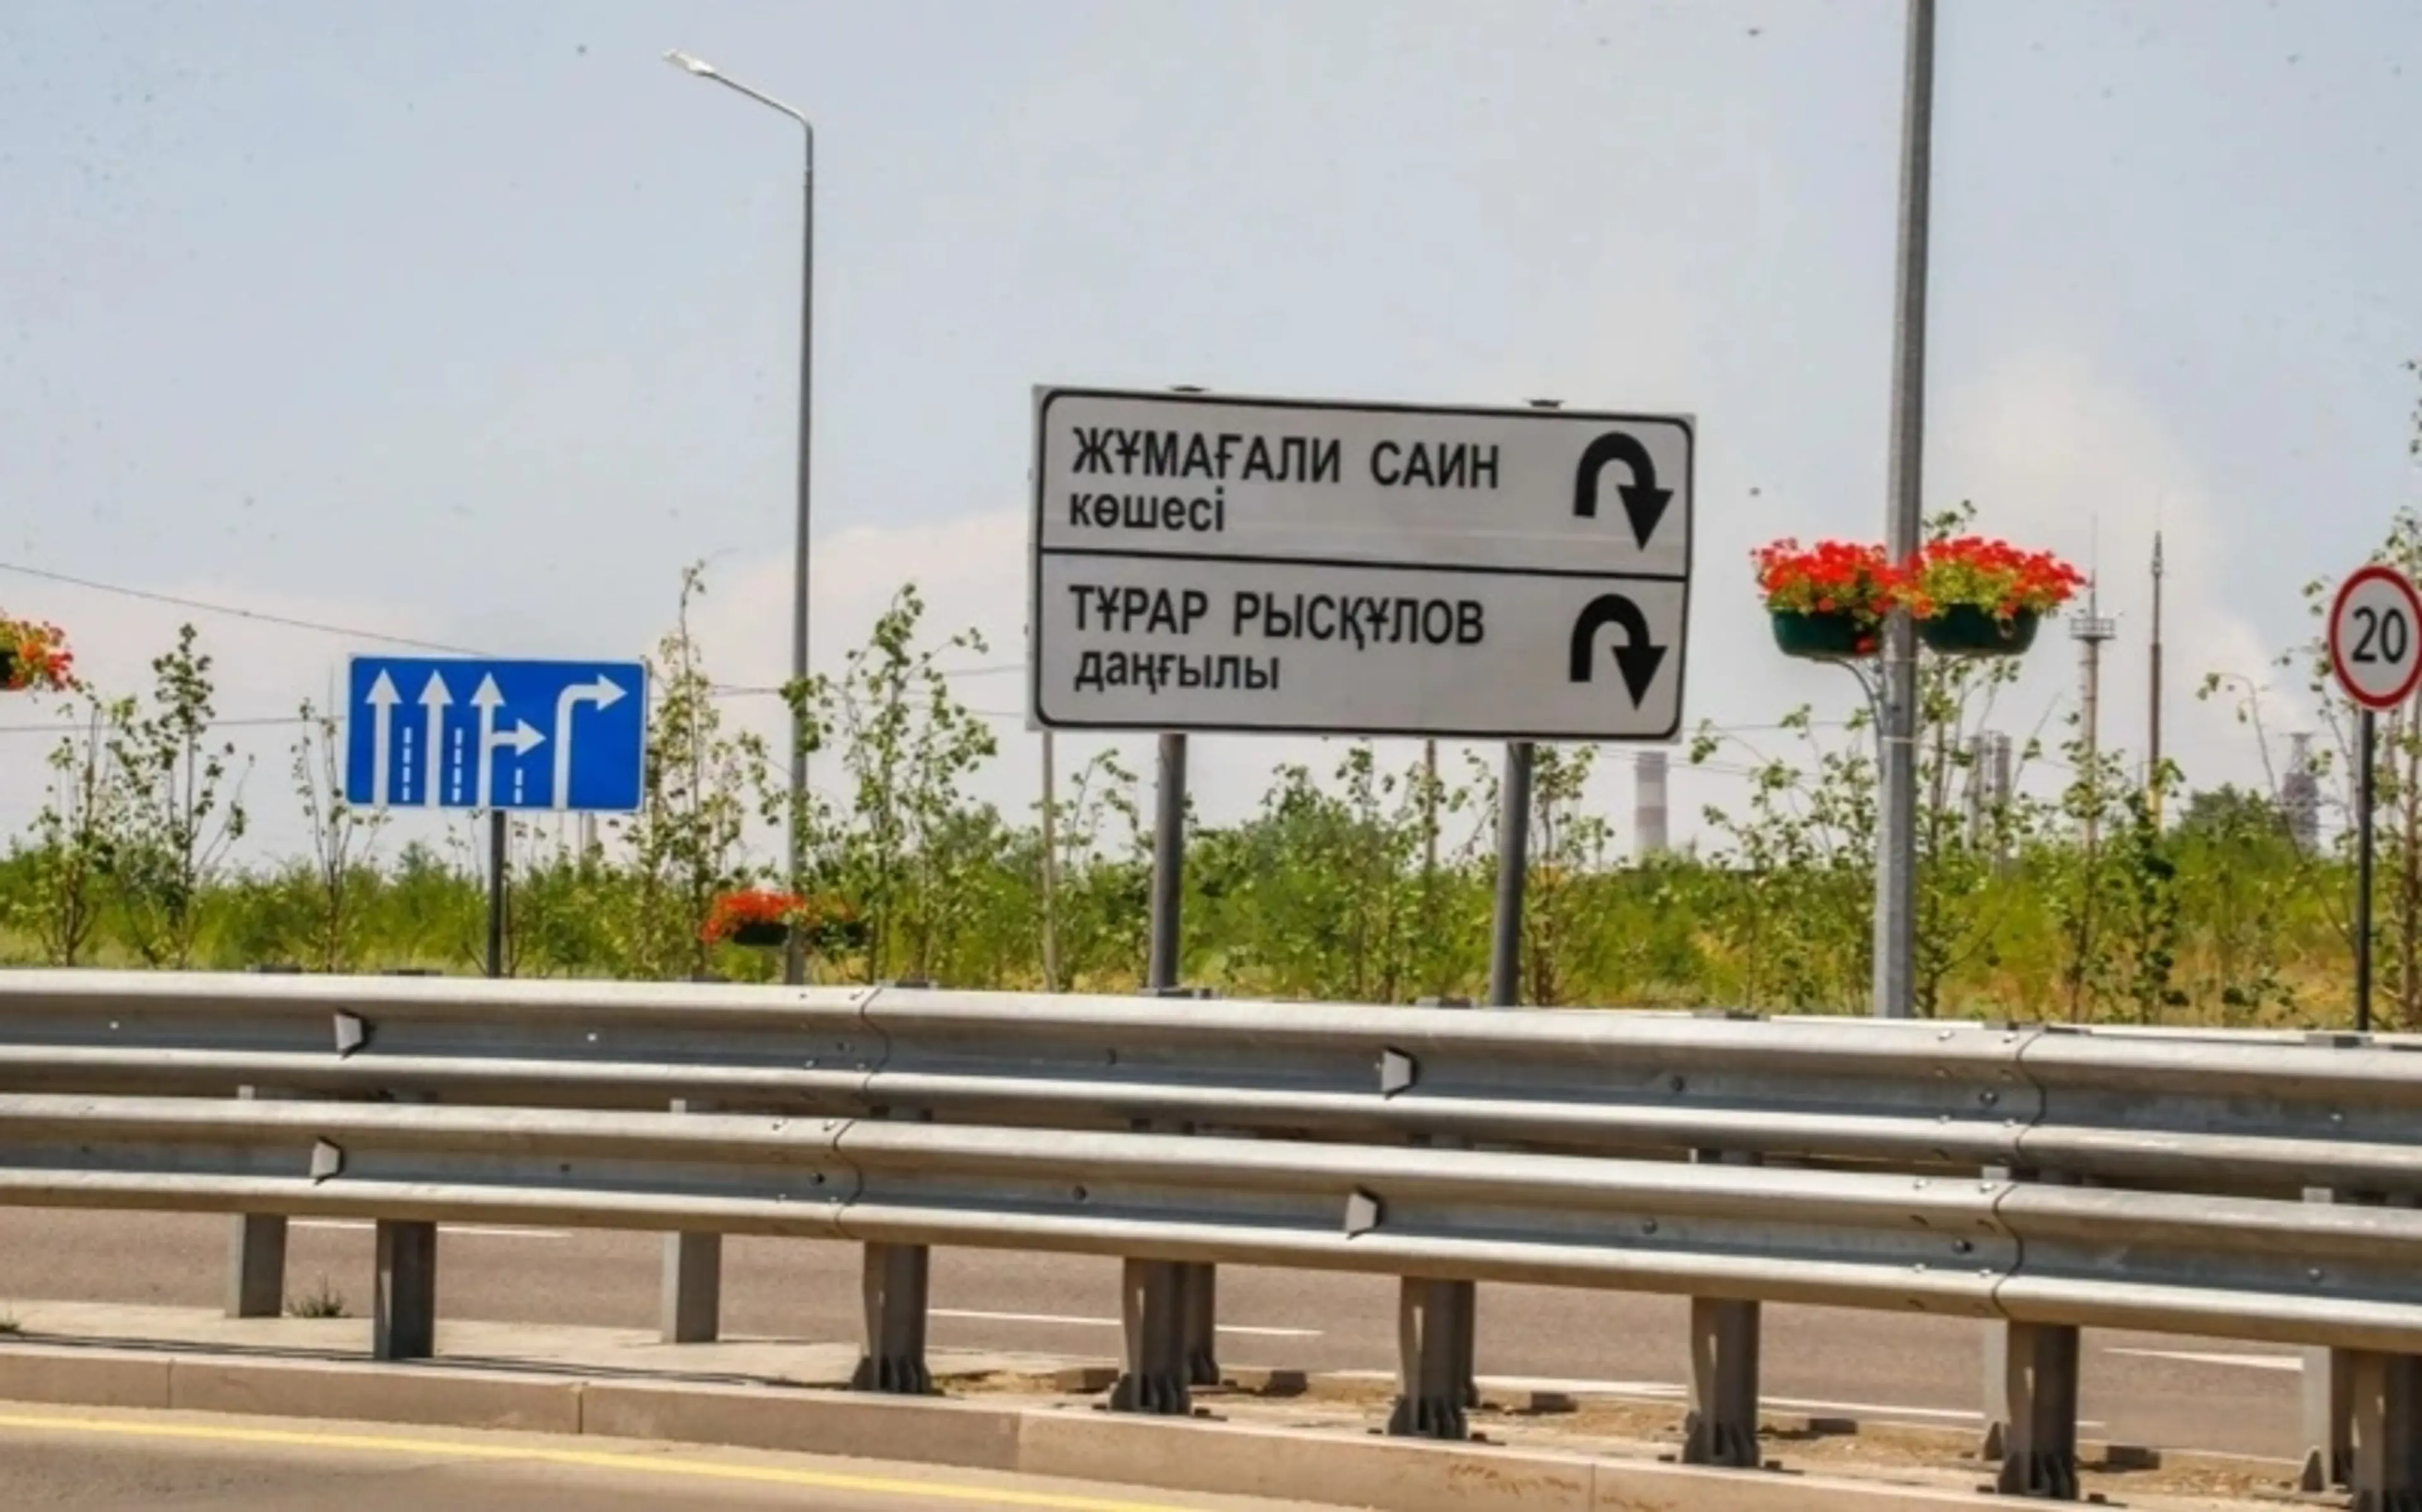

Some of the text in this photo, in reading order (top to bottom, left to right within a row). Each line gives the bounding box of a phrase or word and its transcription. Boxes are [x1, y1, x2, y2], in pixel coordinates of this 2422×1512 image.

[1072, 426, 1499, 490] ЖҰМАҒАЛИ САИН
[1069, 486, 1224, 532] көшесі
[1068, 584, 1485, 652] ТҰРАР РЫСҚҰЛОВ
[2351, 606, 2408, 665] 20
[1074, 651, 1280, 695] даңғылы
